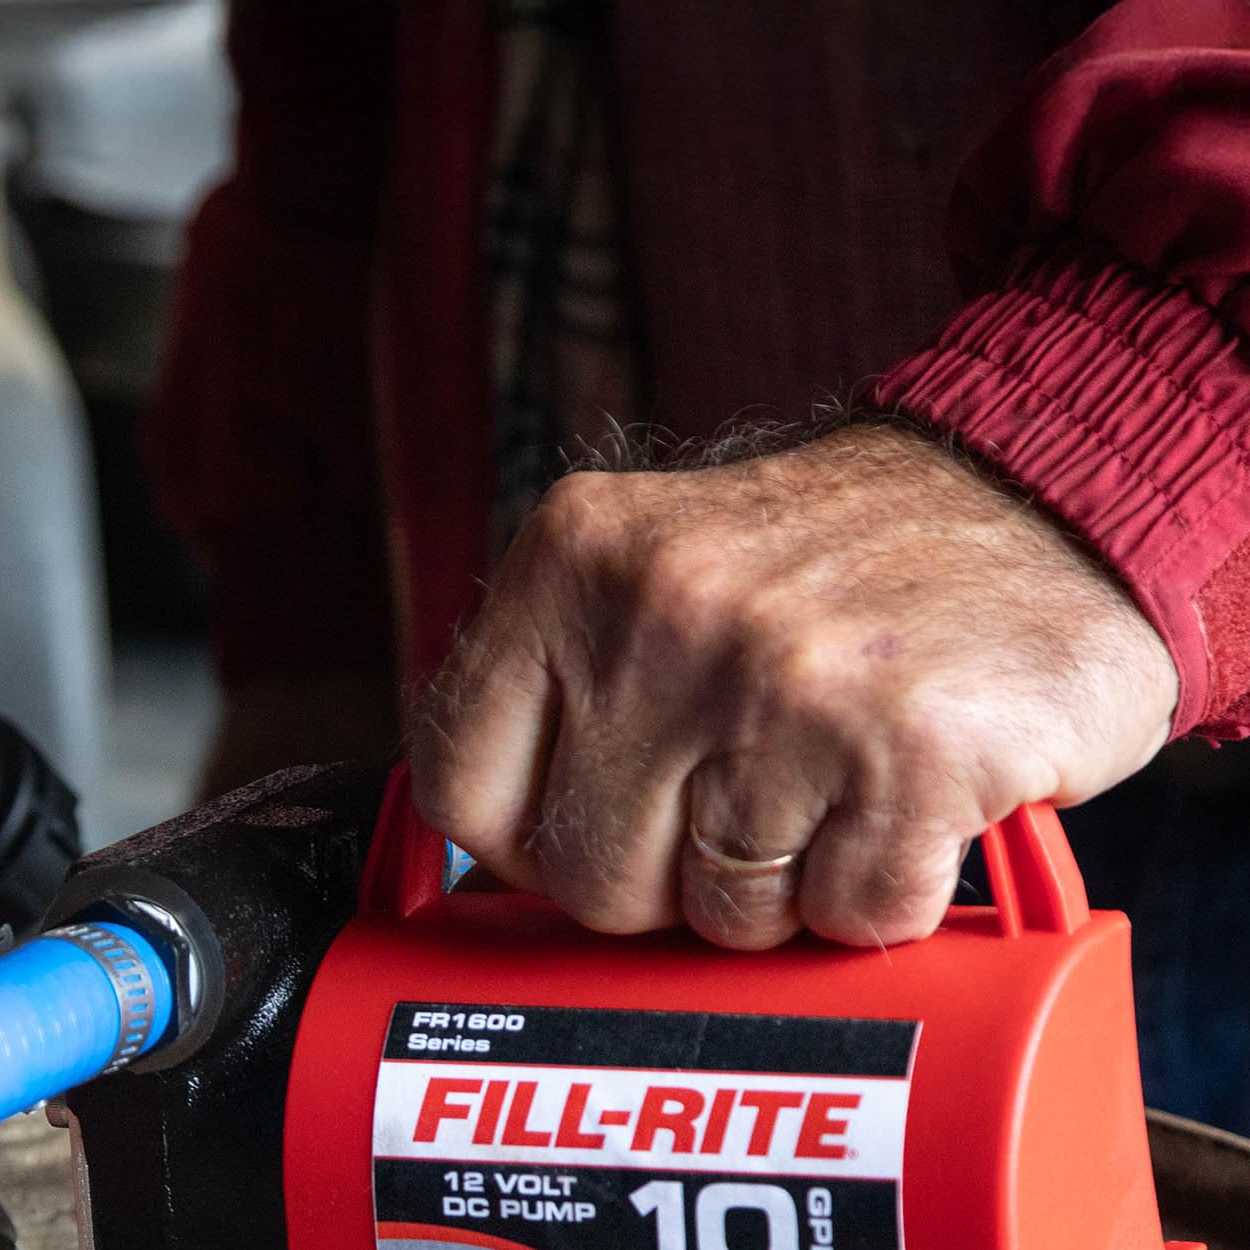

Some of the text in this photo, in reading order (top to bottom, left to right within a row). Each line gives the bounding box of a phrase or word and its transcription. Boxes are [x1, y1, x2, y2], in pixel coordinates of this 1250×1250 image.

[412, 1011, 525, 1031] FR1600
[407, 1033, 491, 1052] Series
[413, 1077, 862, 1160] FILL-RITE
[443, 1171, 578, 1197] 12 VOLT
[442, 1197, 596, 1222] DC PUMP
